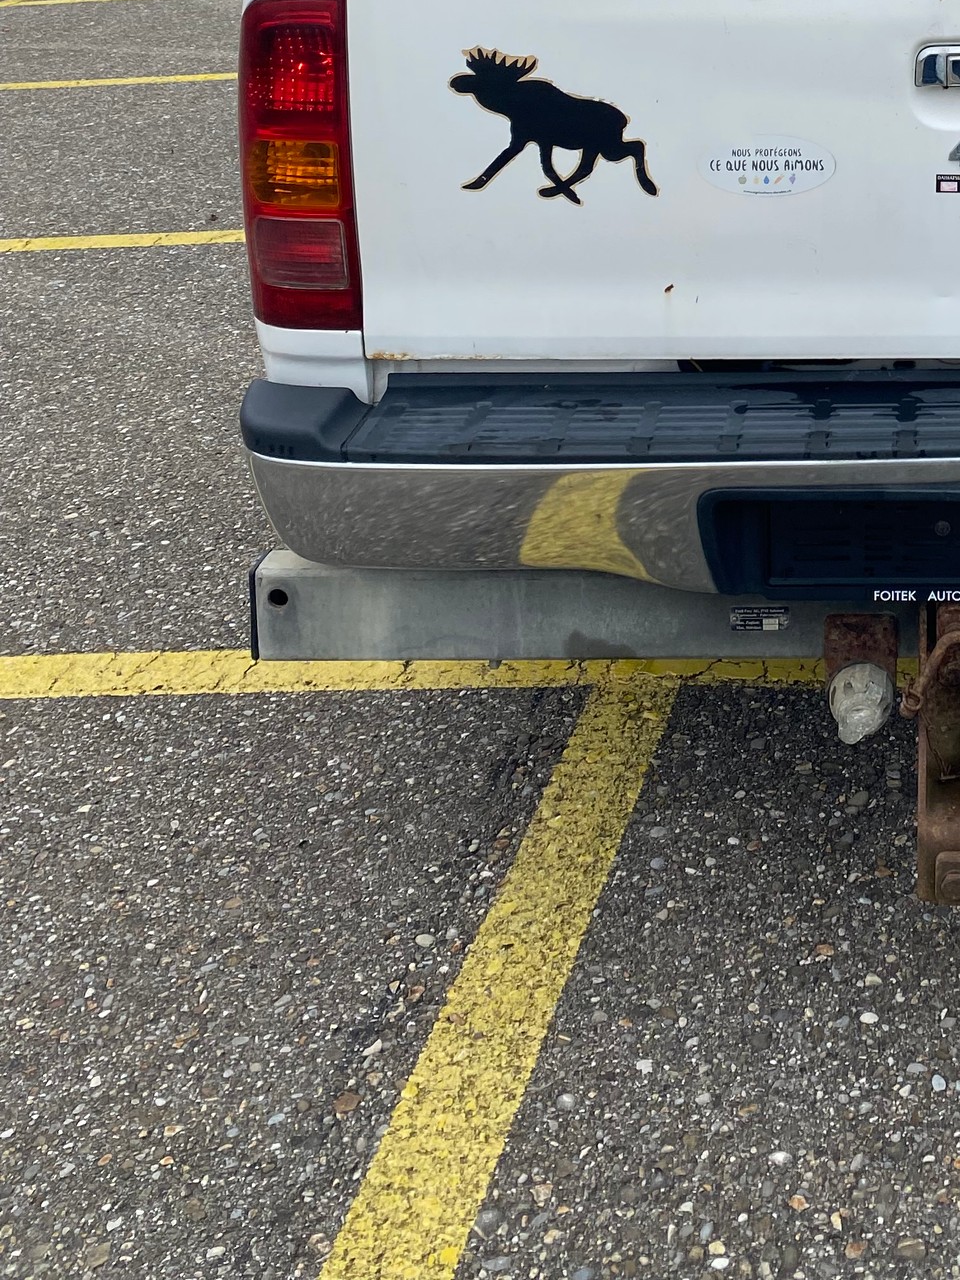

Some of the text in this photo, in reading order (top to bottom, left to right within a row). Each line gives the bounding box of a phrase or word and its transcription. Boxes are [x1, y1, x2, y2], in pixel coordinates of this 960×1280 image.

[731, 147, 802, 157] NOUS PROTÉGEONS
[709, 159, 721, 171] CE
[725, 159, 747, 171] QUE
[751, 159, 780, 171] NOUS
[873, 590, 917, 602] FOITEK
